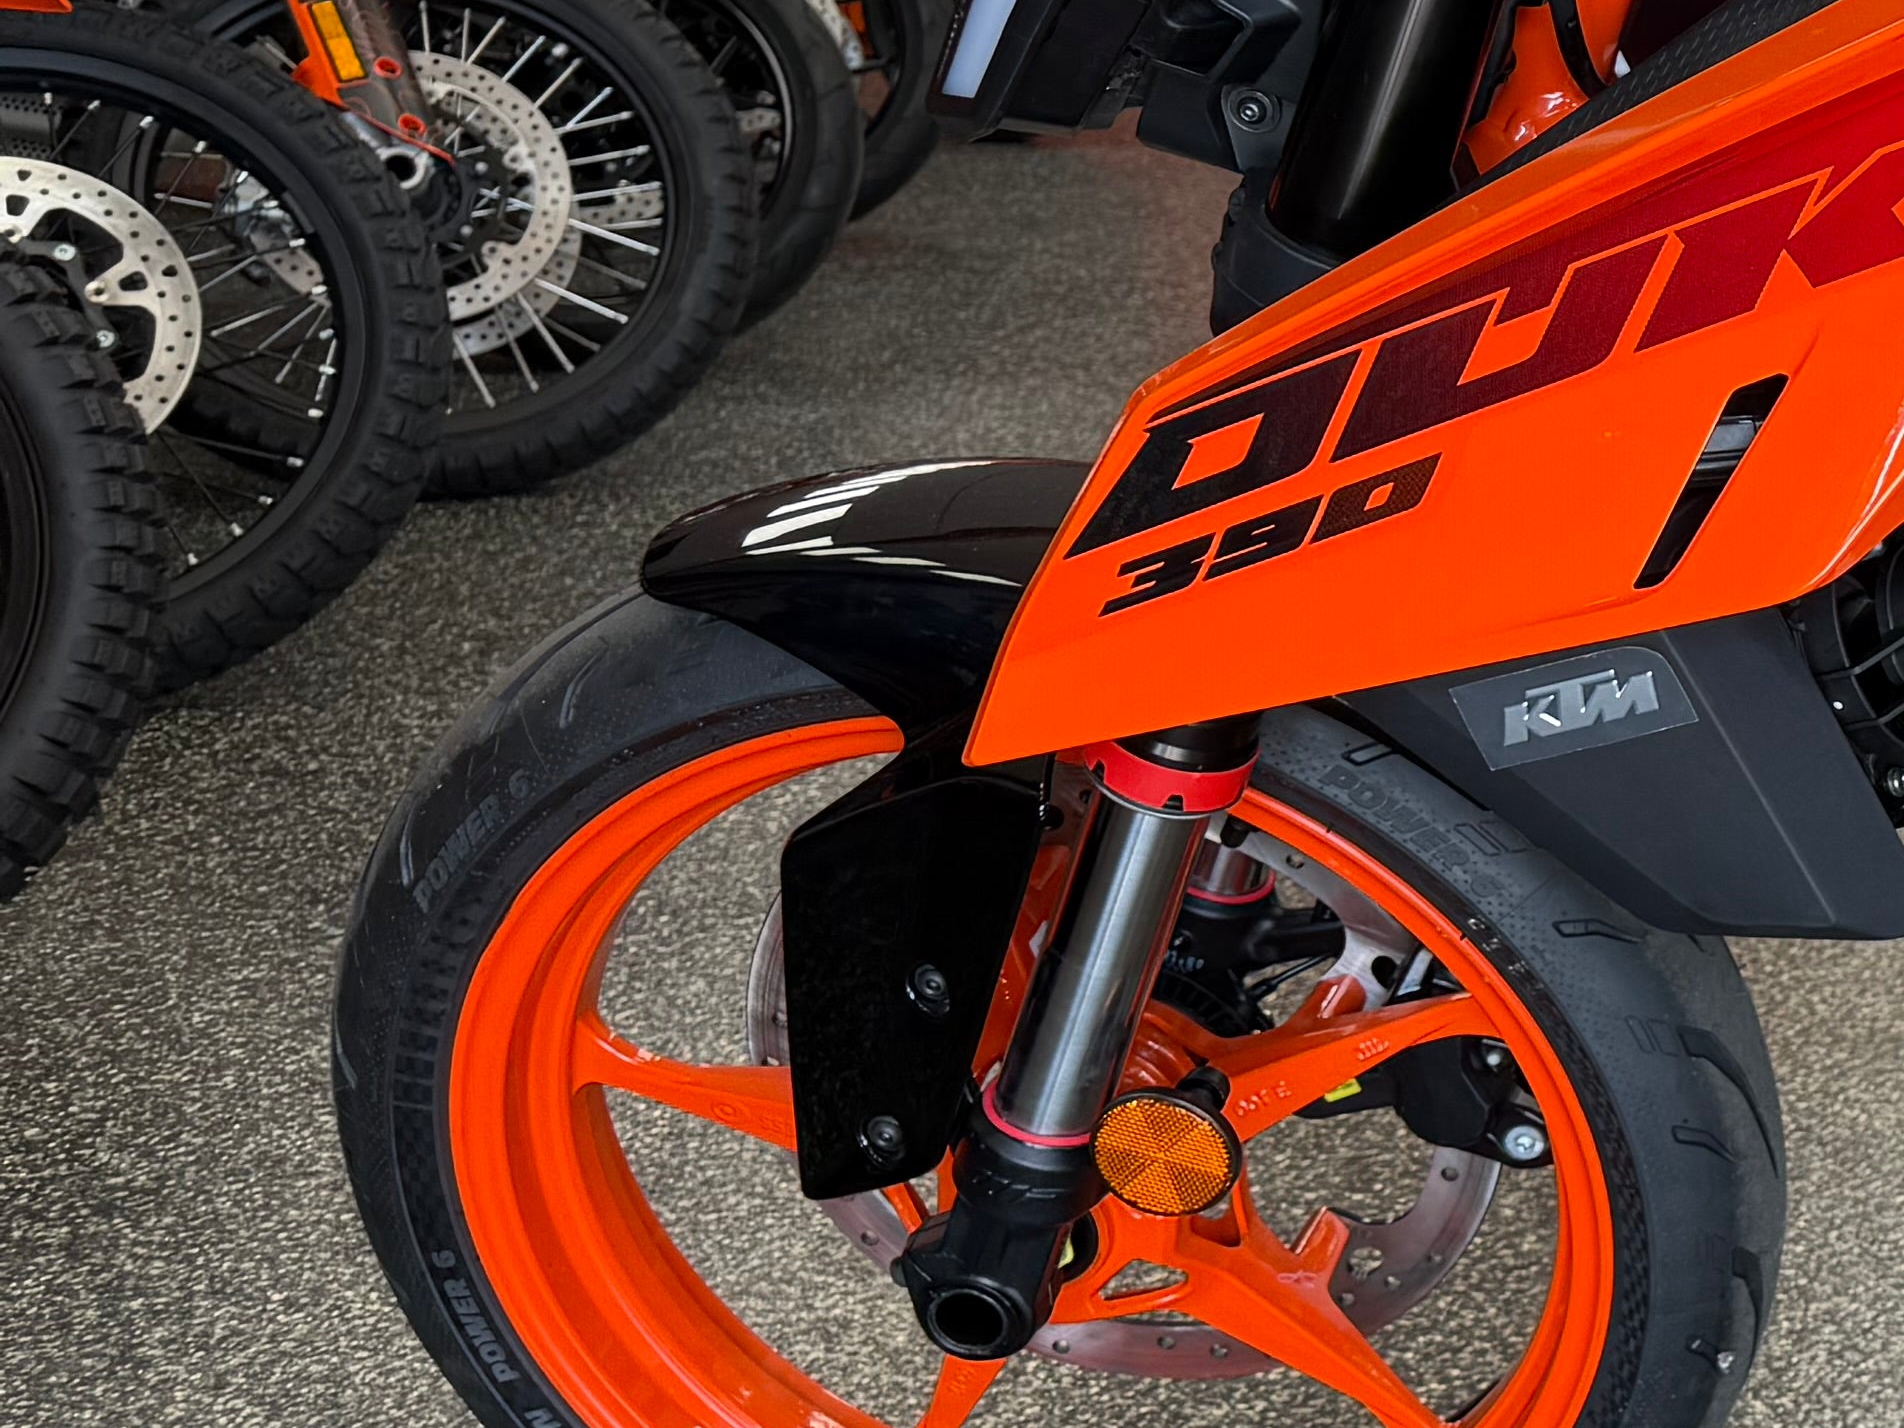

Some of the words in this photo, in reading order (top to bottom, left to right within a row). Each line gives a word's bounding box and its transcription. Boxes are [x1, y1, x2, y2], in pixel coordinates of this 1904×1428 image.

[1098, 452, 1442, 618] 390
[1503, 668, 1661, 747] KTM
[412, 794, 501, 914] POWER
[509, 768, 530, 801] 6
[1317, 764, 1470, 870] POWER
[431, 1249, 457, 1270] 6
[443, 1277, 523, 1384] POWER
